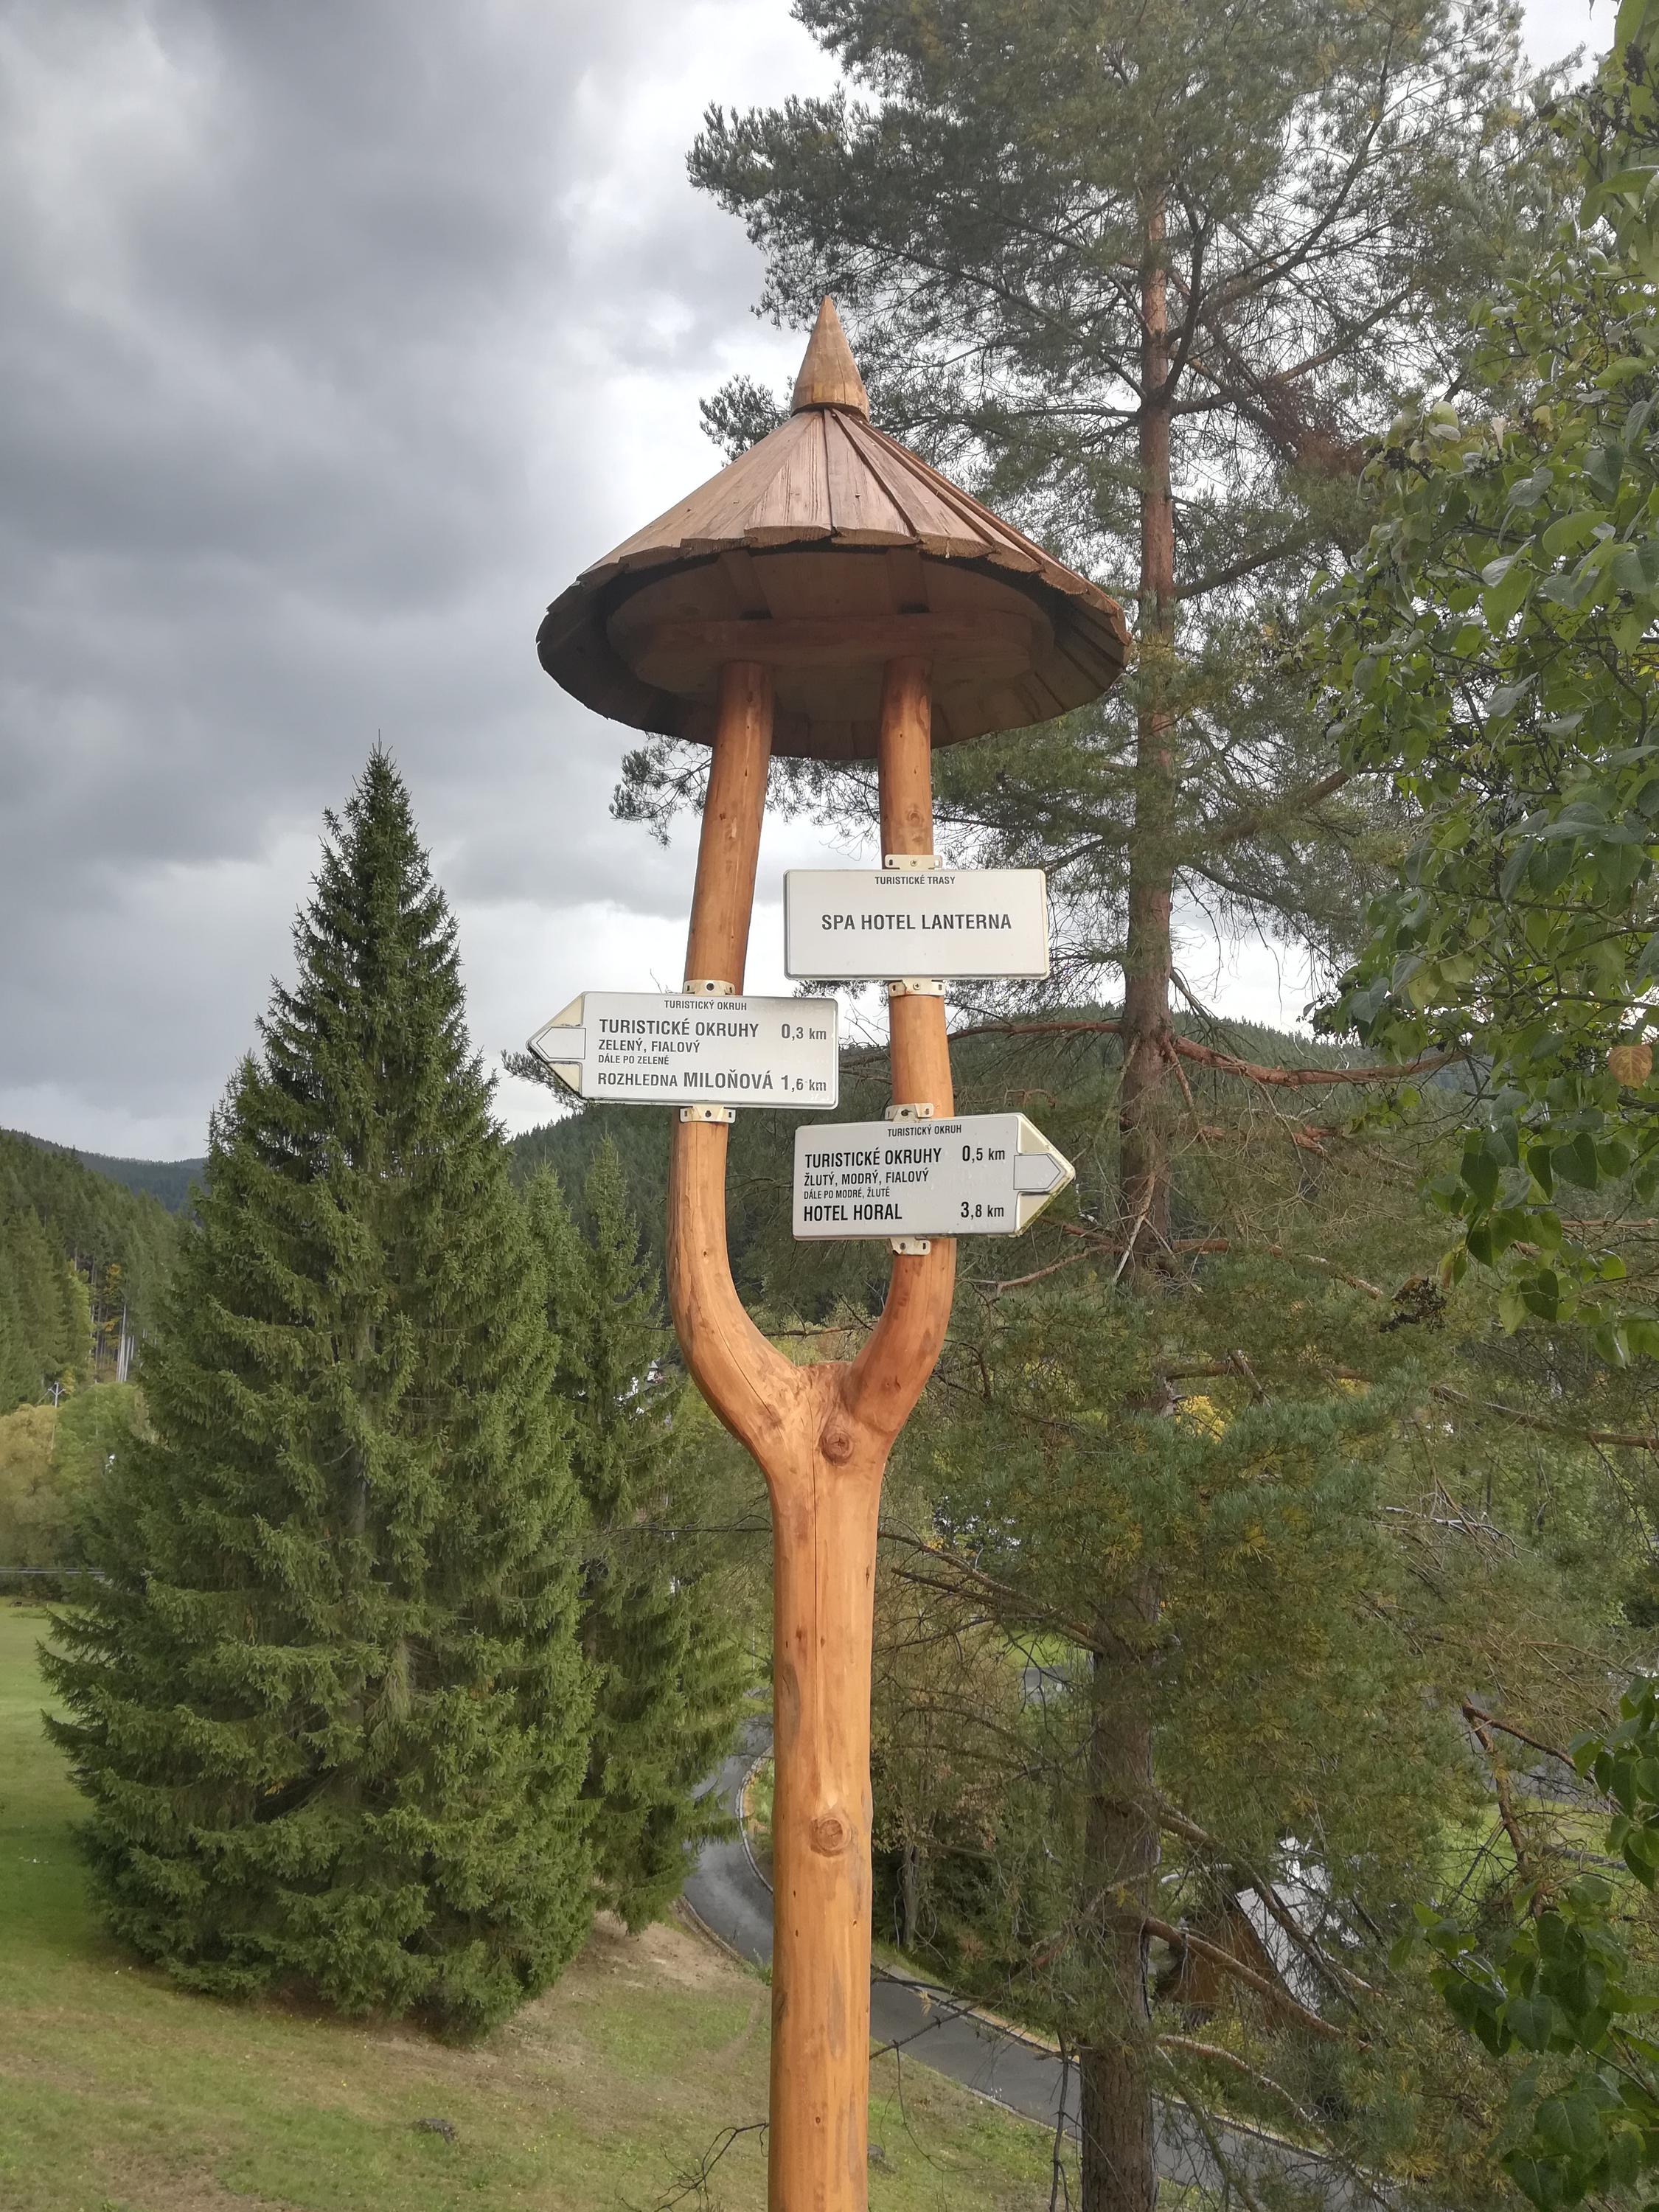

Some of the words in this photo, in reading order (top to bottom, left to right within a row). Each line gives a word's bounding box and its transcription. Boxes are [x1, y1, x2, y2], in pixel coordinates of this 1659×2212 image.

[874, 874, 925, 884] TURISTICKÉ
[928, 876, 956, 885] TRASY
[821, 914, 855, 930] SPA
[861, 914, 916, 930] HOTEL
[922, 914, 1012, 930] LANTERNA
[664, 1000, 714, 1010] TURISTICKÝ
[717, 1002, 747, 1011] OKRUH
[599, 1018, 690, 1035] TURISTICKÉ
[695, 1021, 759, 1037] OKRUHY
[781, 1023, 804, 1041] 0,3
[809, 1028, 827, 1040] km
[598, 1037, 647, 1053] ZELENÝ,
[651, 1040, 700, 1053] FIALOVÝ
[598, 1053, 620, 1063] DÁLE
[623, 1055, 635, 1064] PO
[637, 1055, 669, 1065] ZELENÉ
[597, 1072, 678, 1087] ROZHLEDNA
[684, 1069, 773, 1090] MILOŇOVÁ
[781, 1074, 804, 1093] 1,6
[809, 1079, 827, 1091] km
[887, 1124, 931, 1137] TURISTICKÝ
[934, 1124, 961, 1135] OKRUH
[804, 1147, 880, 1168] TURISTICKÉ
[885, 1147, 942, 1165] OKRUHY
[961, 1145, 983, 1164] 0,5
[988, 1147, 1005, 1161] km
[804, 1172, 838, 1187] ŽLUTÝ,
[841, 1169, 882, 1186] MODRÝ,
[886, 1167, 929, 1183] FIALOVÝ
[804, 1189, 822, 1200] DÁLE
[824, 1190, 834, 1199] PO
[835, 1187, 865, 1199] MODRÉ,
[866, 1186, 890, 1197] ŽLUTÉ
[804, 1205, 848, 1221] HOTEL
[853, 1203, 902, 1220] HORAL
[961, 1201, 982, 1220] 3,8
[987, 1204, 1004, 1217] km
